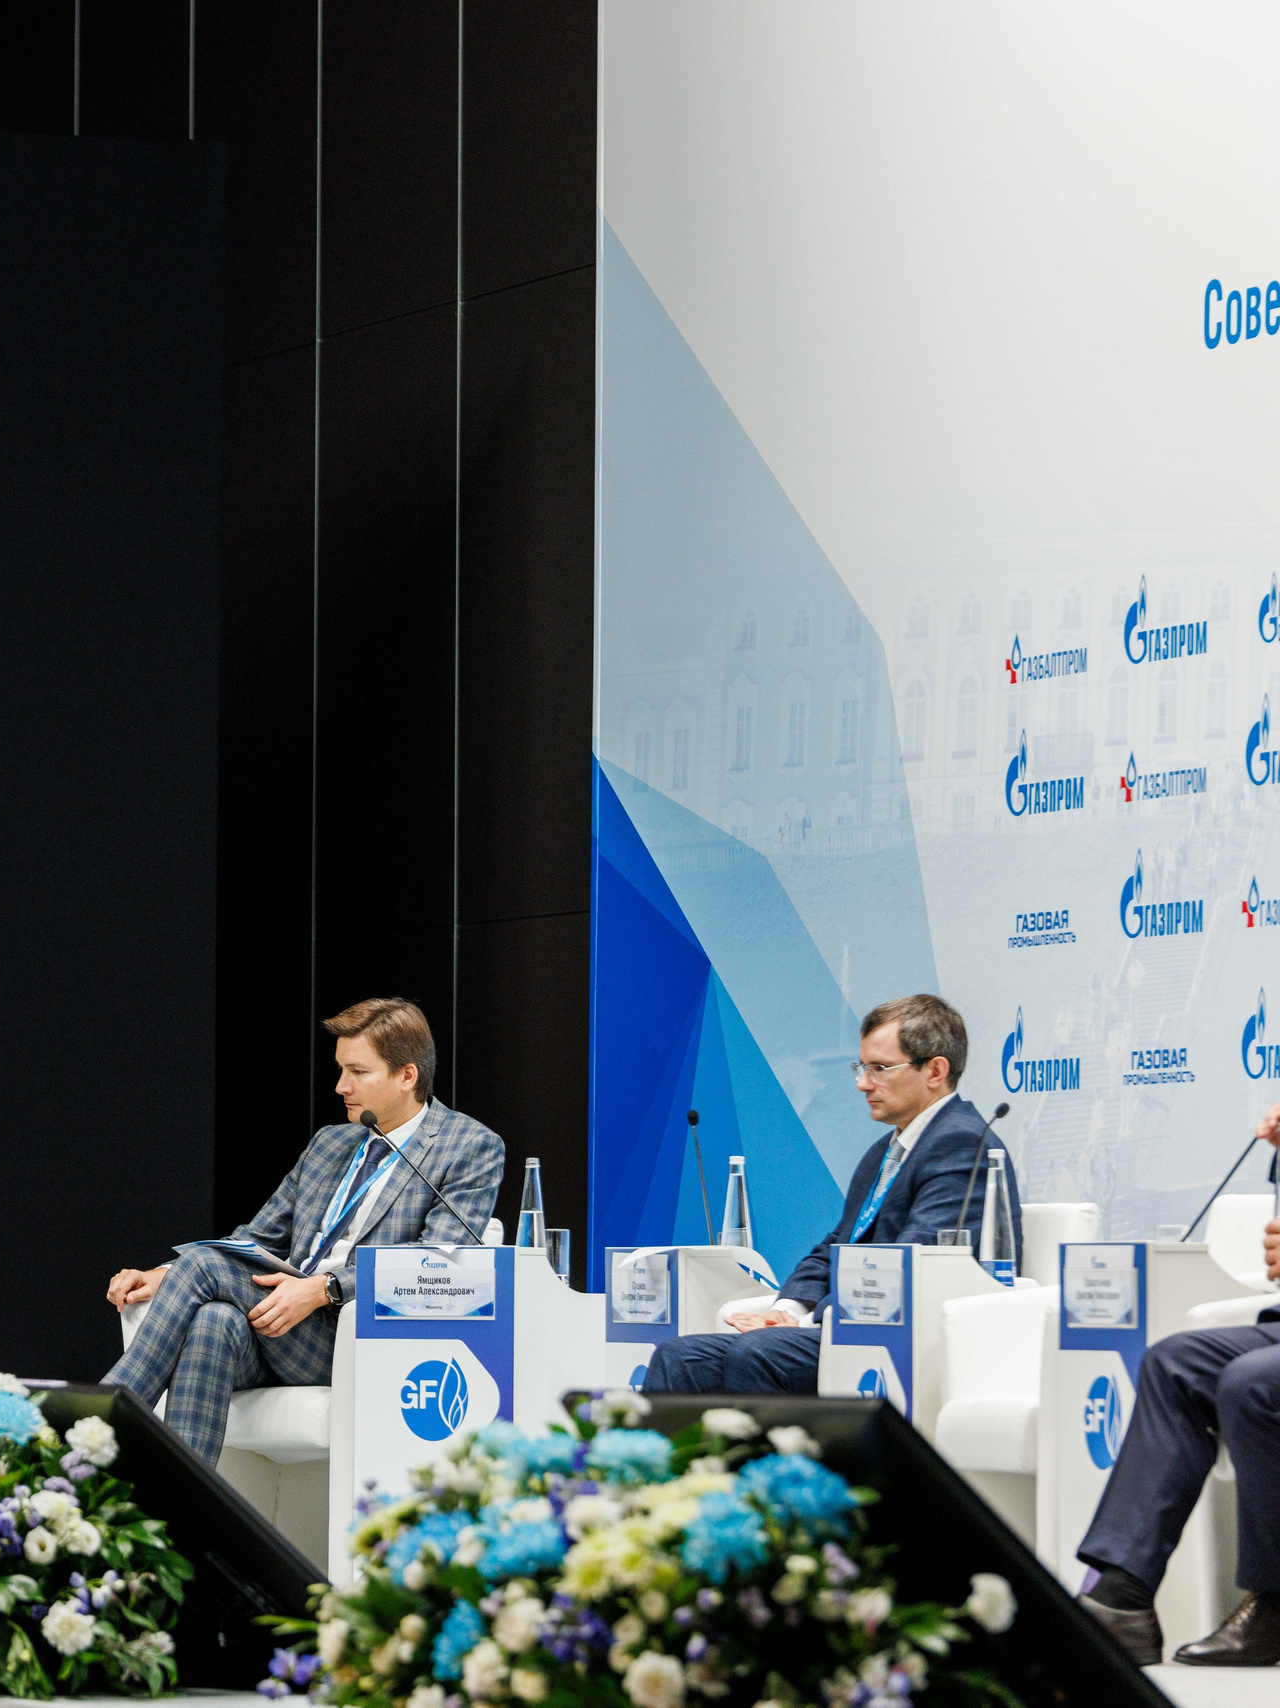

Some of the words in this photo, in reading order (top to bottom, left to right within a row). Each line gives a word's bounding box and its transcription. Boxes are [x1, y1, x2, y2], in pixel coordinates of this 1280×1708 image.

[1148, 620, 1207, 662] ГАЗПРОМ
[1021, 647, 1088, 682] ГАЗБАЛТПРОМ
[1029, 776, 1084, 815] ГАЗПРОМ
[1136, 766, 1207, 800] ГАЗБАЛТПРОМ
[1016, 909, 1069, 933] ГАЗОВАЯ
[1144, 899, 1203, 937] ГАЗПРОМ
[1260, 899, 1280, 926] ГАЗ
[1008, 931, 1077, 948] ПРОМЫШЛЕННОСТЬ
[1131, 1048, 1187, 1070] ГАЗОВАЯ
[1024, 1057, 1080, 1093] ГАЗПРОМ
[1123, 1070, 1195, 1086] ПРОМЫШЛЕННОСТЬ
[393, 1286, 416, 1297] Артем
[418, 1286, 475, 1297] Александрович
[417, 1275, 451, 1285] Ямщиков
[397, 1379, 438, 1410] GF
[1082, 1398, 1105, 1433] GF
